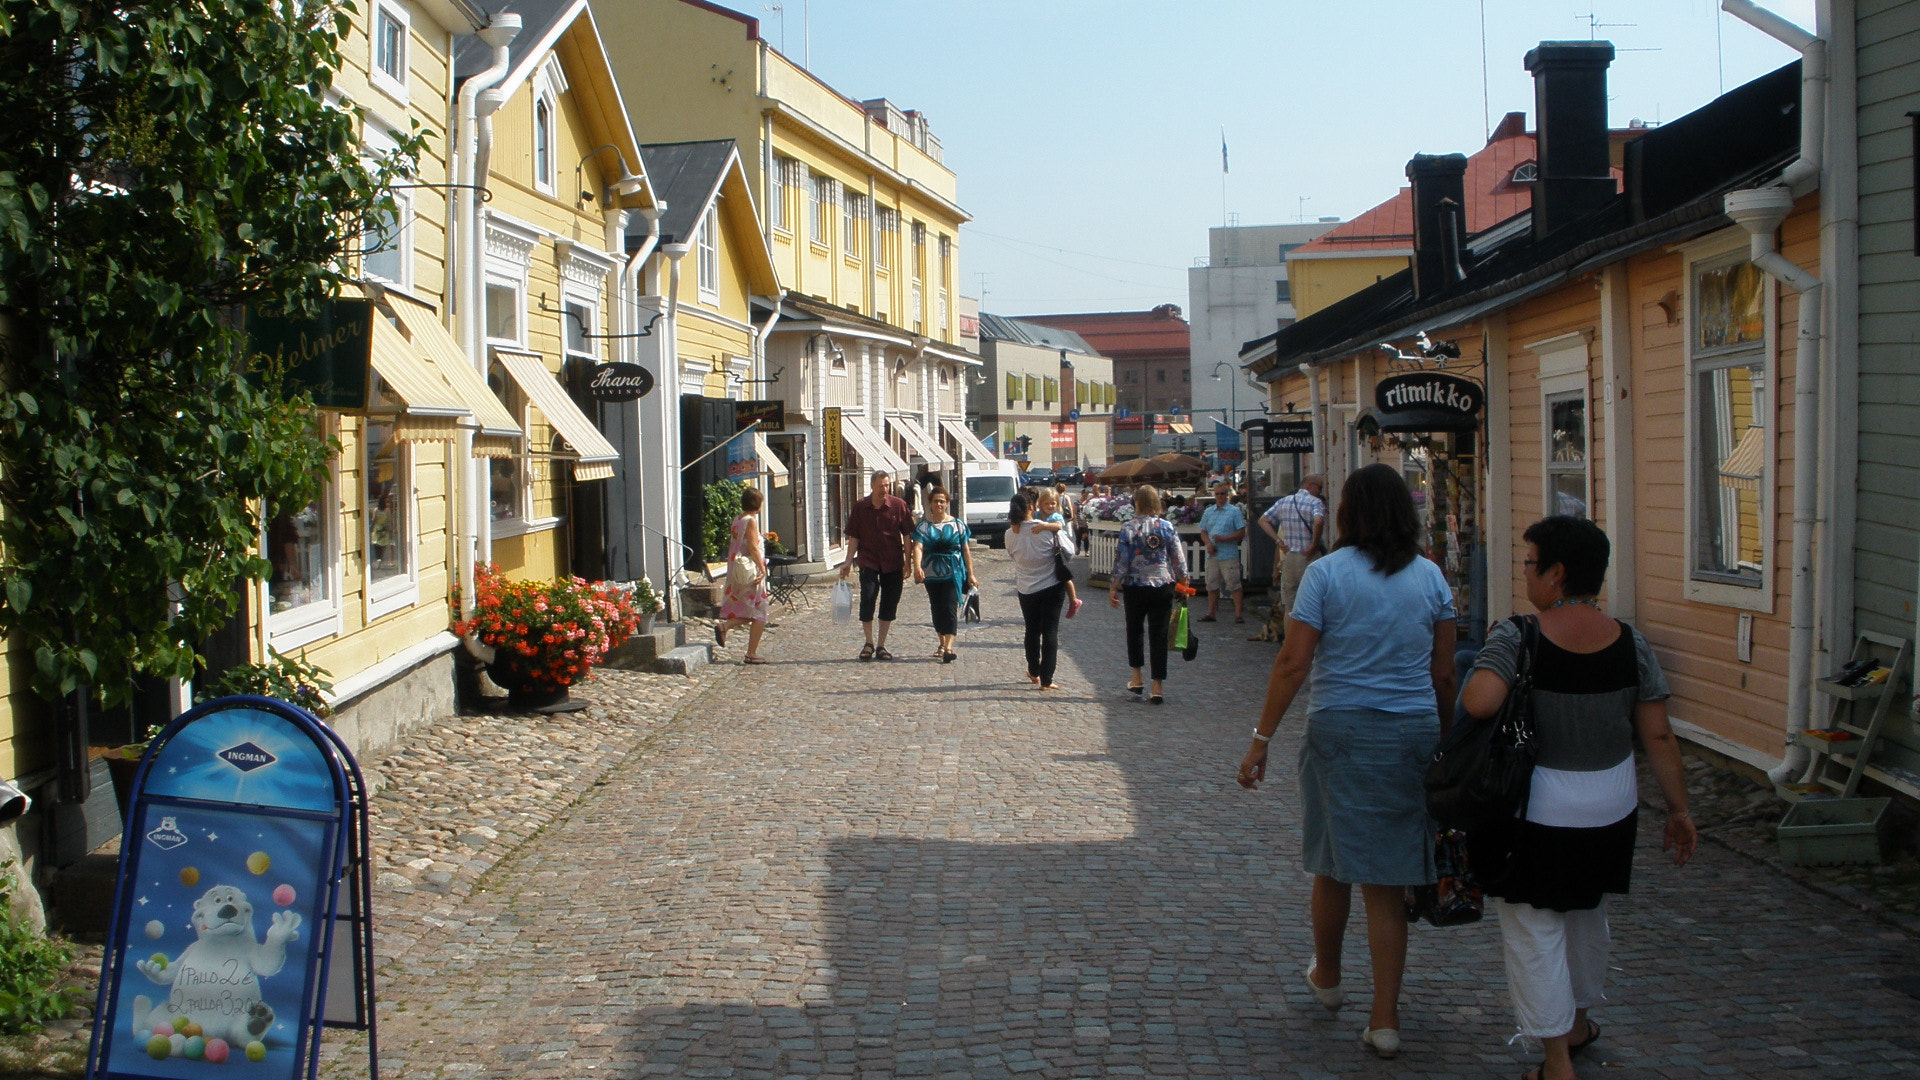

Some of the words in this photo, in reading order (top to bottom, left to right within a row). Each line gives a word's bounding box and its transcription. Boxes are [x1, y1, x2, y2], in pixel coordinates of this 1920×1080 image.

[592, 388, 642, 396] LIVING
[1385, 381, 1472, 412] riimikko
[828, 415, 839, 464] WIKSTRÖM
[1269, 435, 1313, 449] SKARPMAN
[227, 751, 267, 763] INGMAN
[153, 833, 182, 843] INGMAN
[220, 958, 240, 986] 2
[167, 988, 189, 1015] 2
